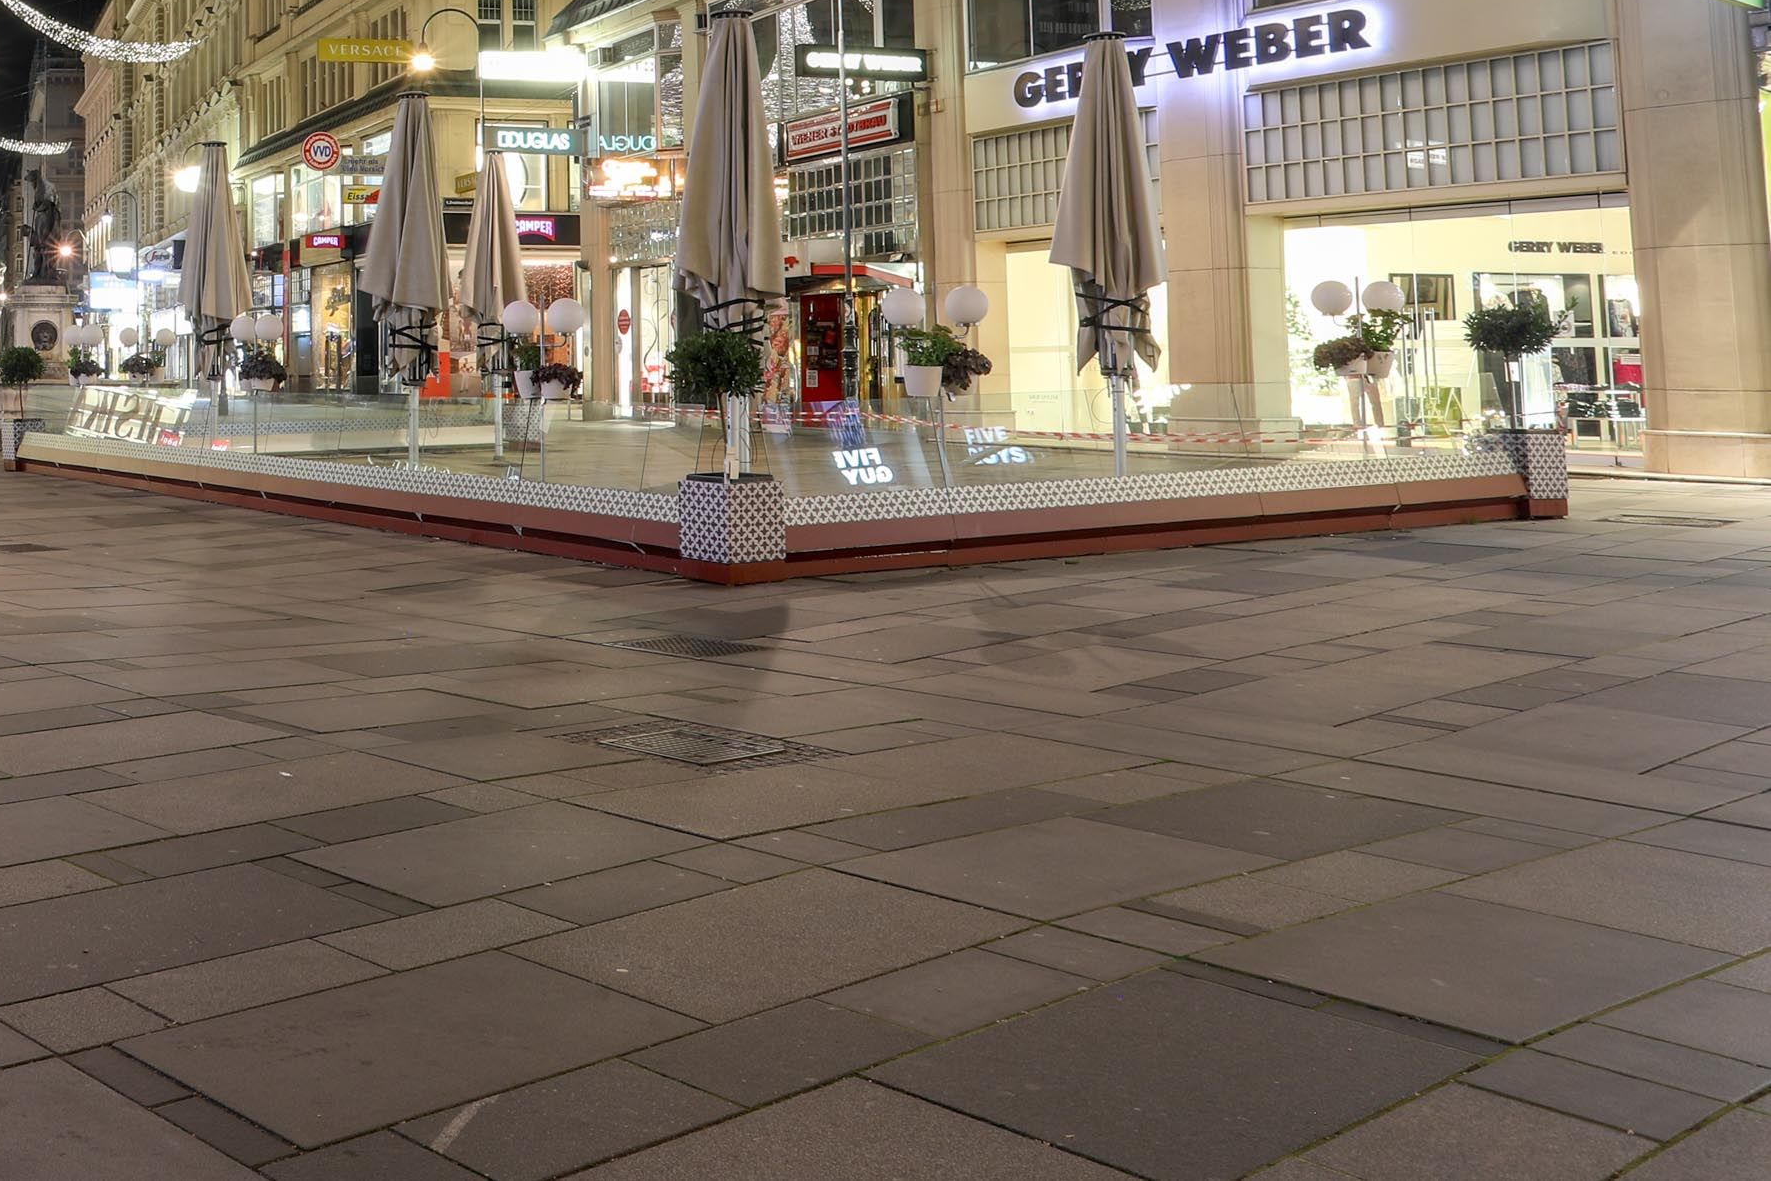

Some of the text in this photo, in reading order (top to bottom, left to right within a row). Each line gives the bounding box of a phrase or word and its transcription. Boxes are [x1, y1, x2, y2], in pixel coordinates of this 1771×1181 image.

[328, 44, 404, 57] VERSACE
[1167, 9, 1371, 79] WEBER
[497, 130, 570, 150] DOUGLAS
[515, 219, 553, 236] CAMPER
[313, 236, 338, 246] CAMPER
[1508, 241, 1553, 253] GERRY
[1556, 242, 1604, 254] WEBER
